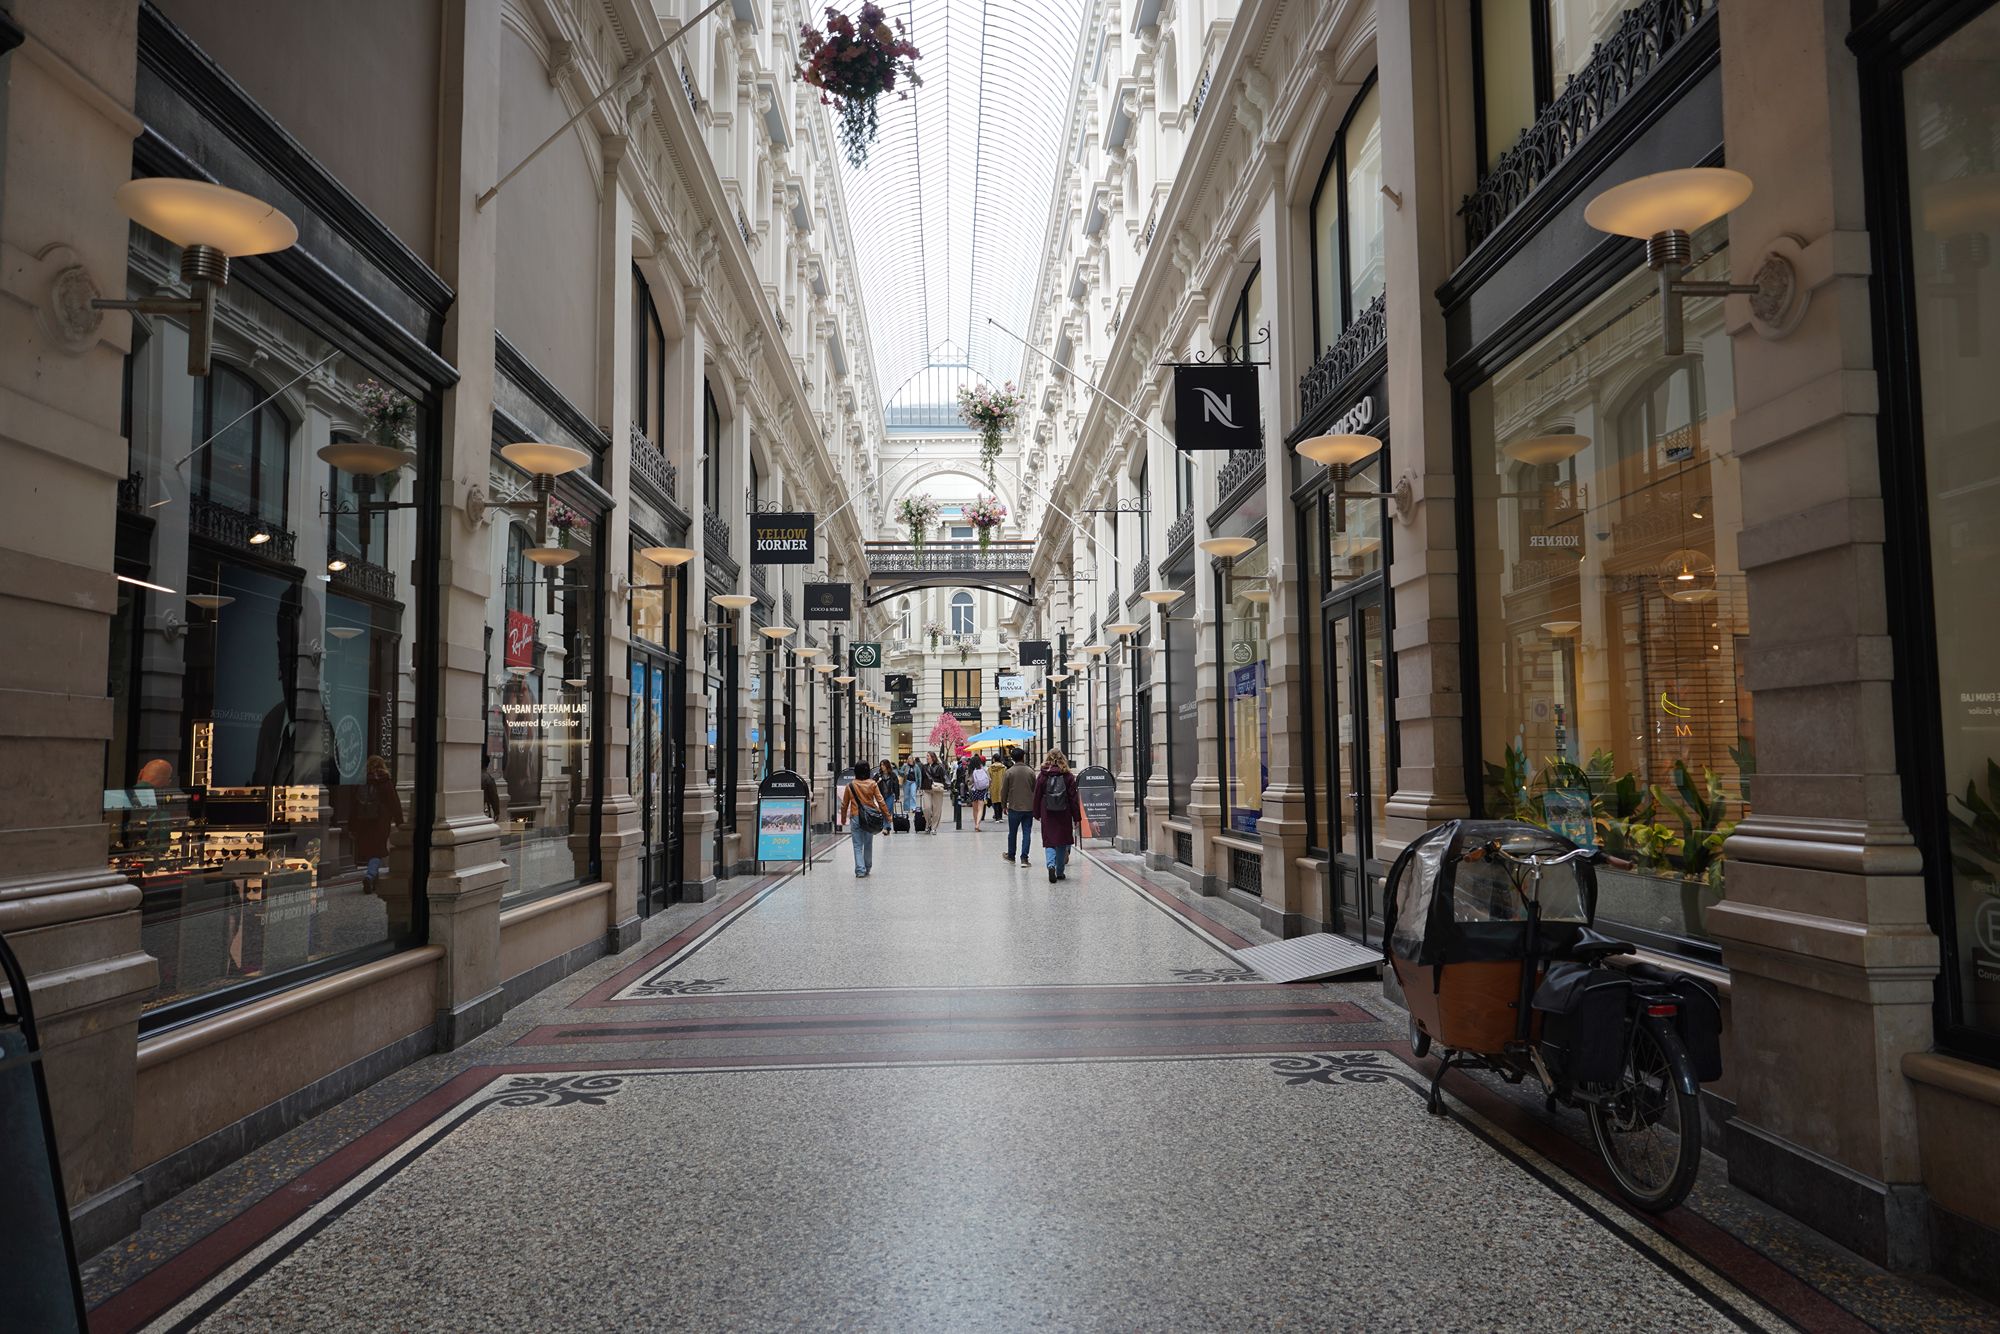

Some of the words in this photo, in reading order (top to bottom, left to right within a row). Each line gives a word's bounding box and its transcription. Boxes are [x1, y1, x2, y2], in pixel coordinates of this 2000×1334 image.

[1192, 387, 1244, 429] N
[757, 529, 808, 539] YELLOW
[757, 539, 808, 551] KORNER
[502, 704, 531, 714] AY-BAN
[533, 704, 548, 714] EYE
[572, 704, 587, 714] LAB
[506, 719, 539, 727] owered
[541, 719, 551, 729] by
[553, 719, 580, 727] Essilor
